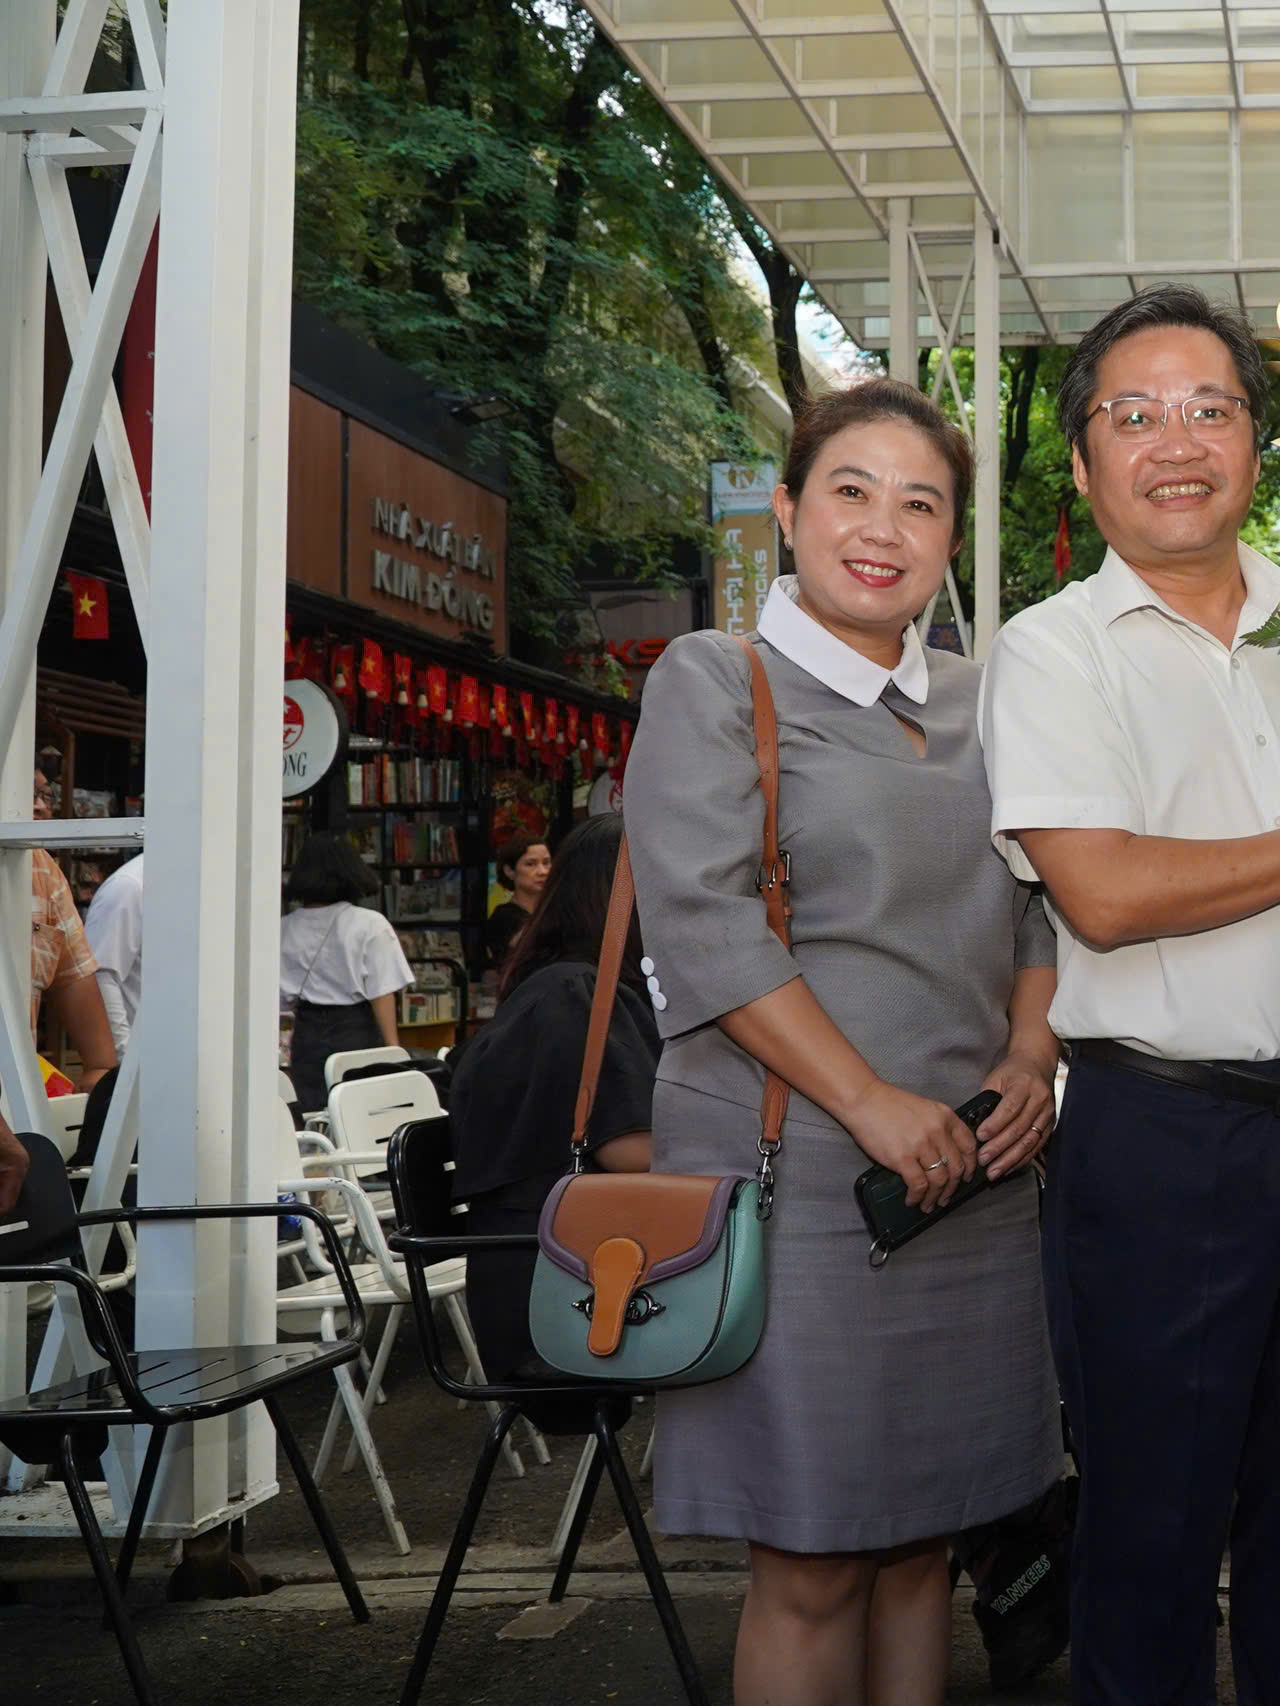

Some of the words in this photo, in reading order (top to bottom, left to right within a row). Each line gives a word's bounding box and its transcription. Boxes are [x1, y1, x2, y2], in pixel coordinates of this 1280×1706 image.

[372, 497, 415, 545] NHÀ
[373, 548, 422, 605] KIM
[990, 1554, 1051, 1615] YANKEES
